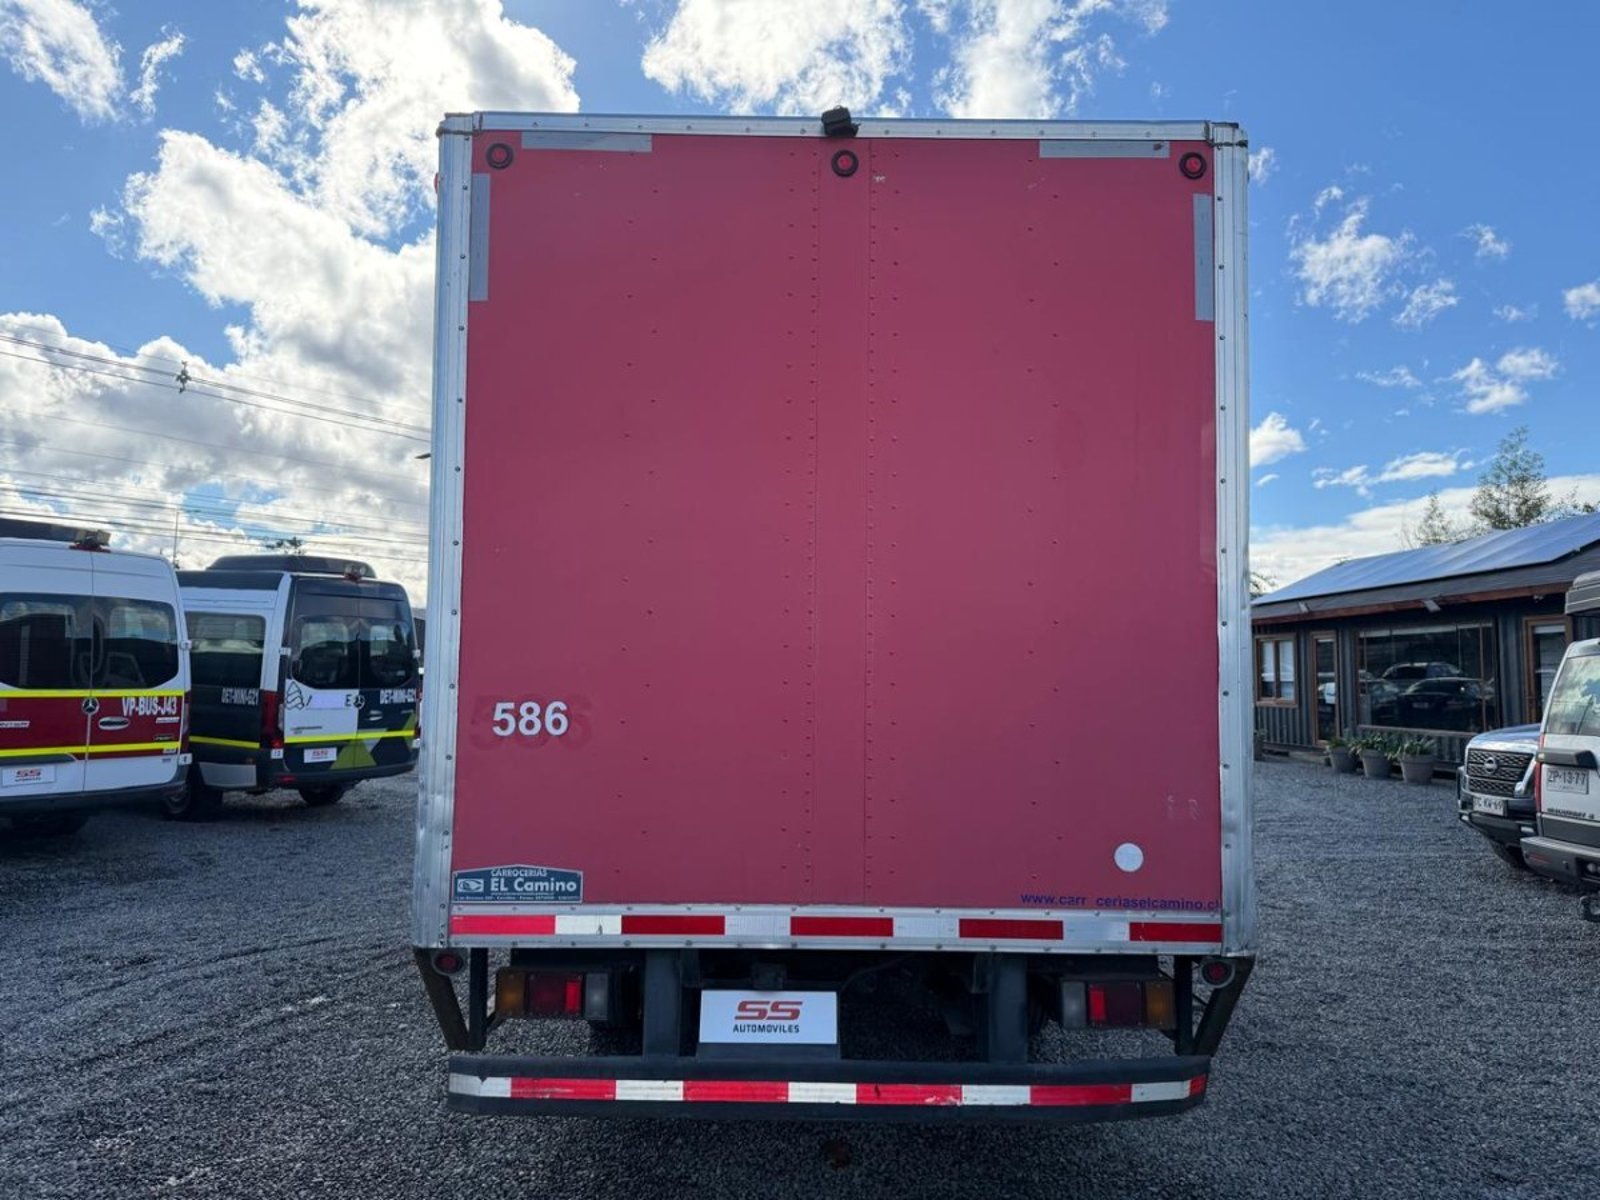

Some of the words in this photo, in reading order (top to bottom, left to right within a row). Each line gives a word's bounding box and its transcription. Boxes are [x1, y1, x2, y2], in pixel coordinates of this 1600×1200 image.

[122, 696, 177, 716] VP-BUS-J43
[492, 701, 569, 736] 586
[490, 868, 548, 877] CARROCERIAS
[490, 878, 508, 891] EL
[514, 878, 577, 892] Camino
[734, 1001, 803, 1021] SS
[732, 1024, 800, 1034] AUTOMOVILES
